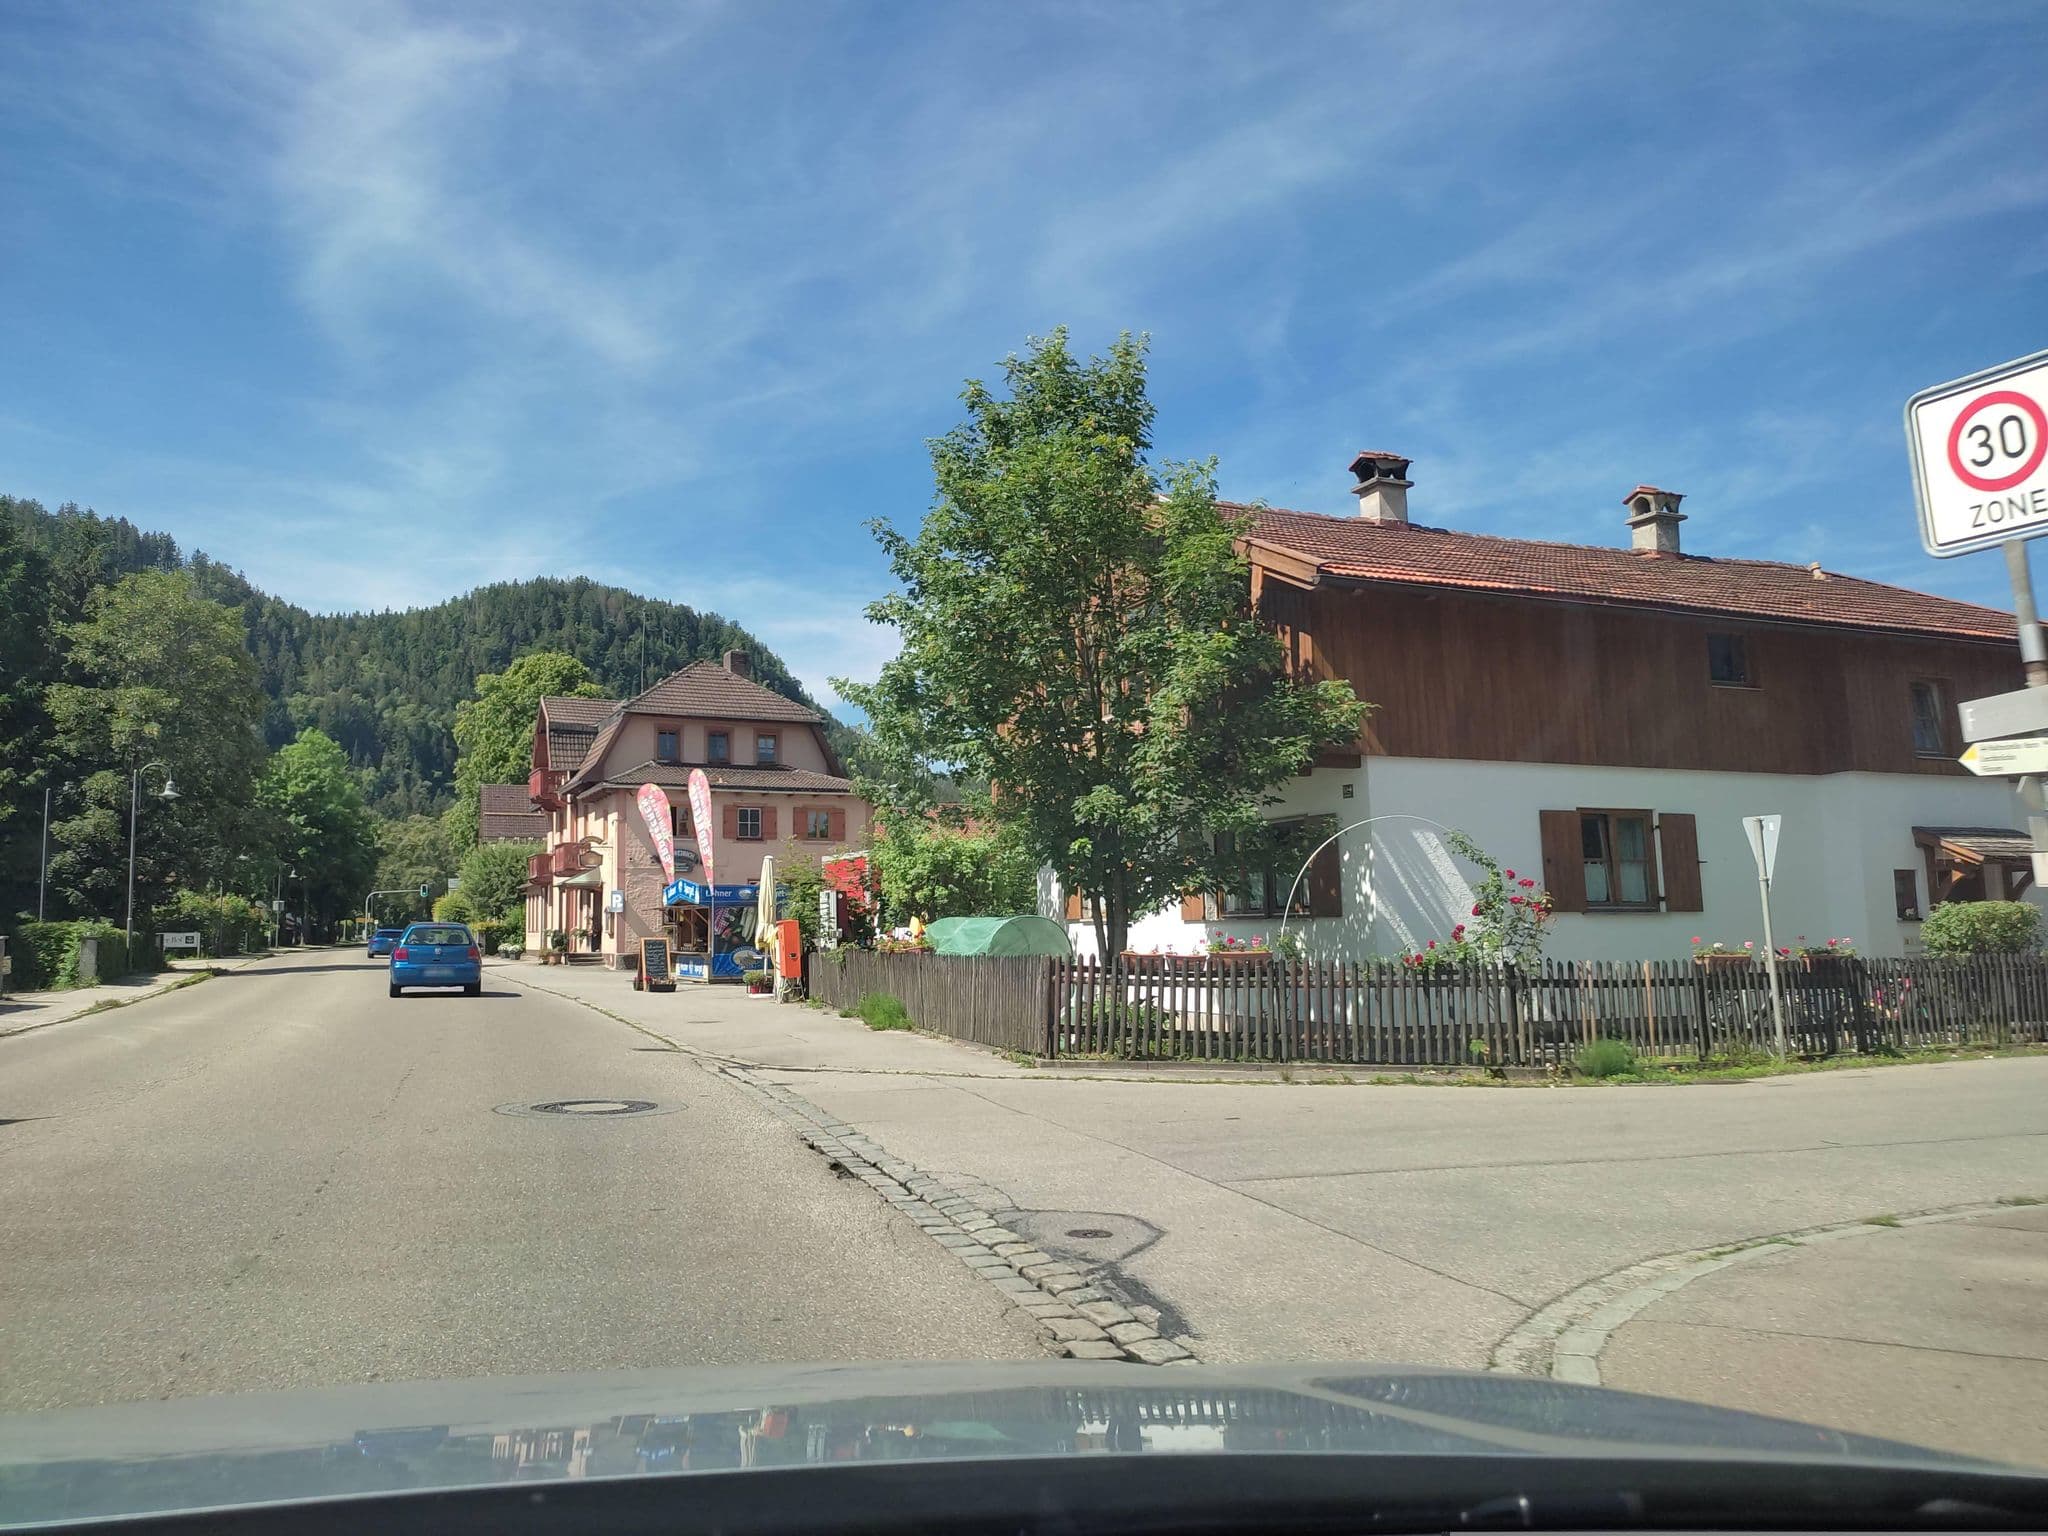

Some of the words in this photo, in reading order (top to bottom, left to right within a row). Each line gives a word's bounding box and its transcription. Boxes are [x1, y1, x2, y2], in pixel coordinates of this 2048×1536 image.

[1967, 415, 2026, 467] 30
[1969, 488, 2048, 528] ZONE
[612, 893, 623, 908] P
